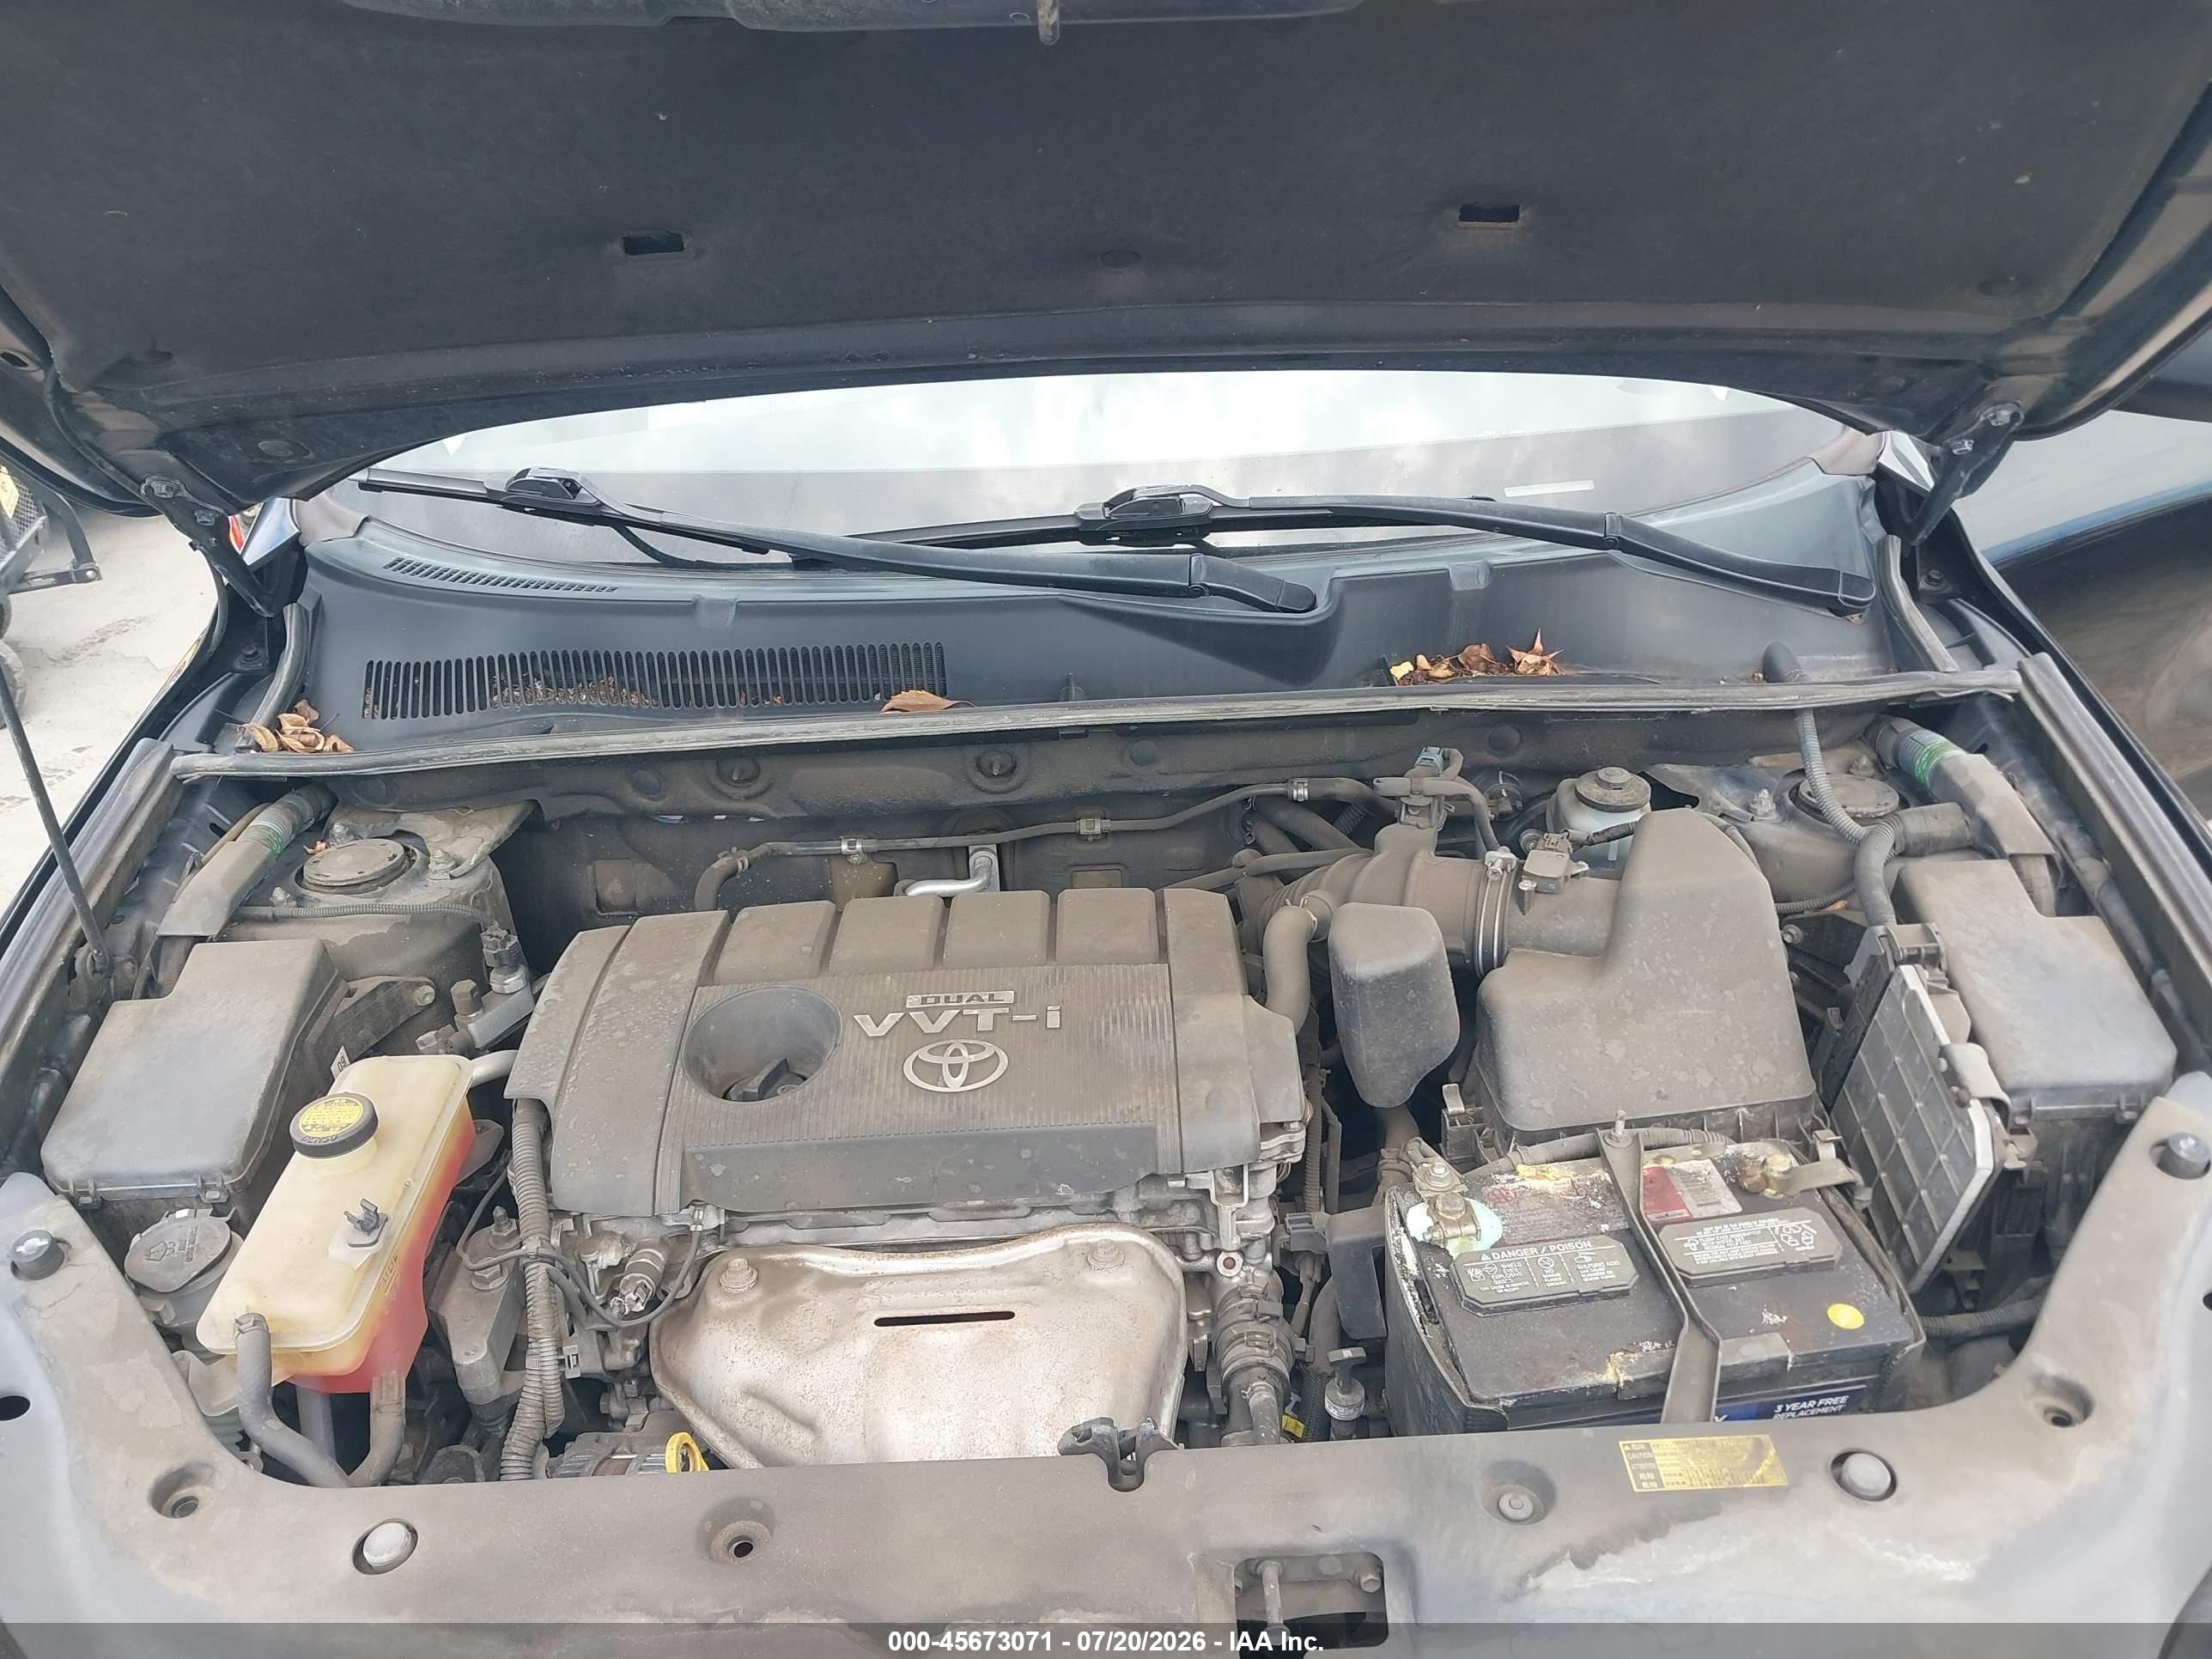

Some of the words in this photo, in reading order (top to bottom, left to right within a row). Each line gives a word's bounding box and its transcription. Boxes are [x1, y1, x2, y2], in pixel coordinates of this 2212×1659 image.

[921, 993, 1006, 1006] DUAL
[853, 1006, 1062, 1037] VVT-i
[1492, 1247, 1539, 1261] DANGER
[1549, 1241, 1592, 1253] POISON
[1772, 1405, 1847, 1420] REPLACEMENT
[1774, 1404, 1784, 1413] 3
[1785, 1399, 1816, 1412] YEAR
[1817, 1395, 1850, 1407] FREE
